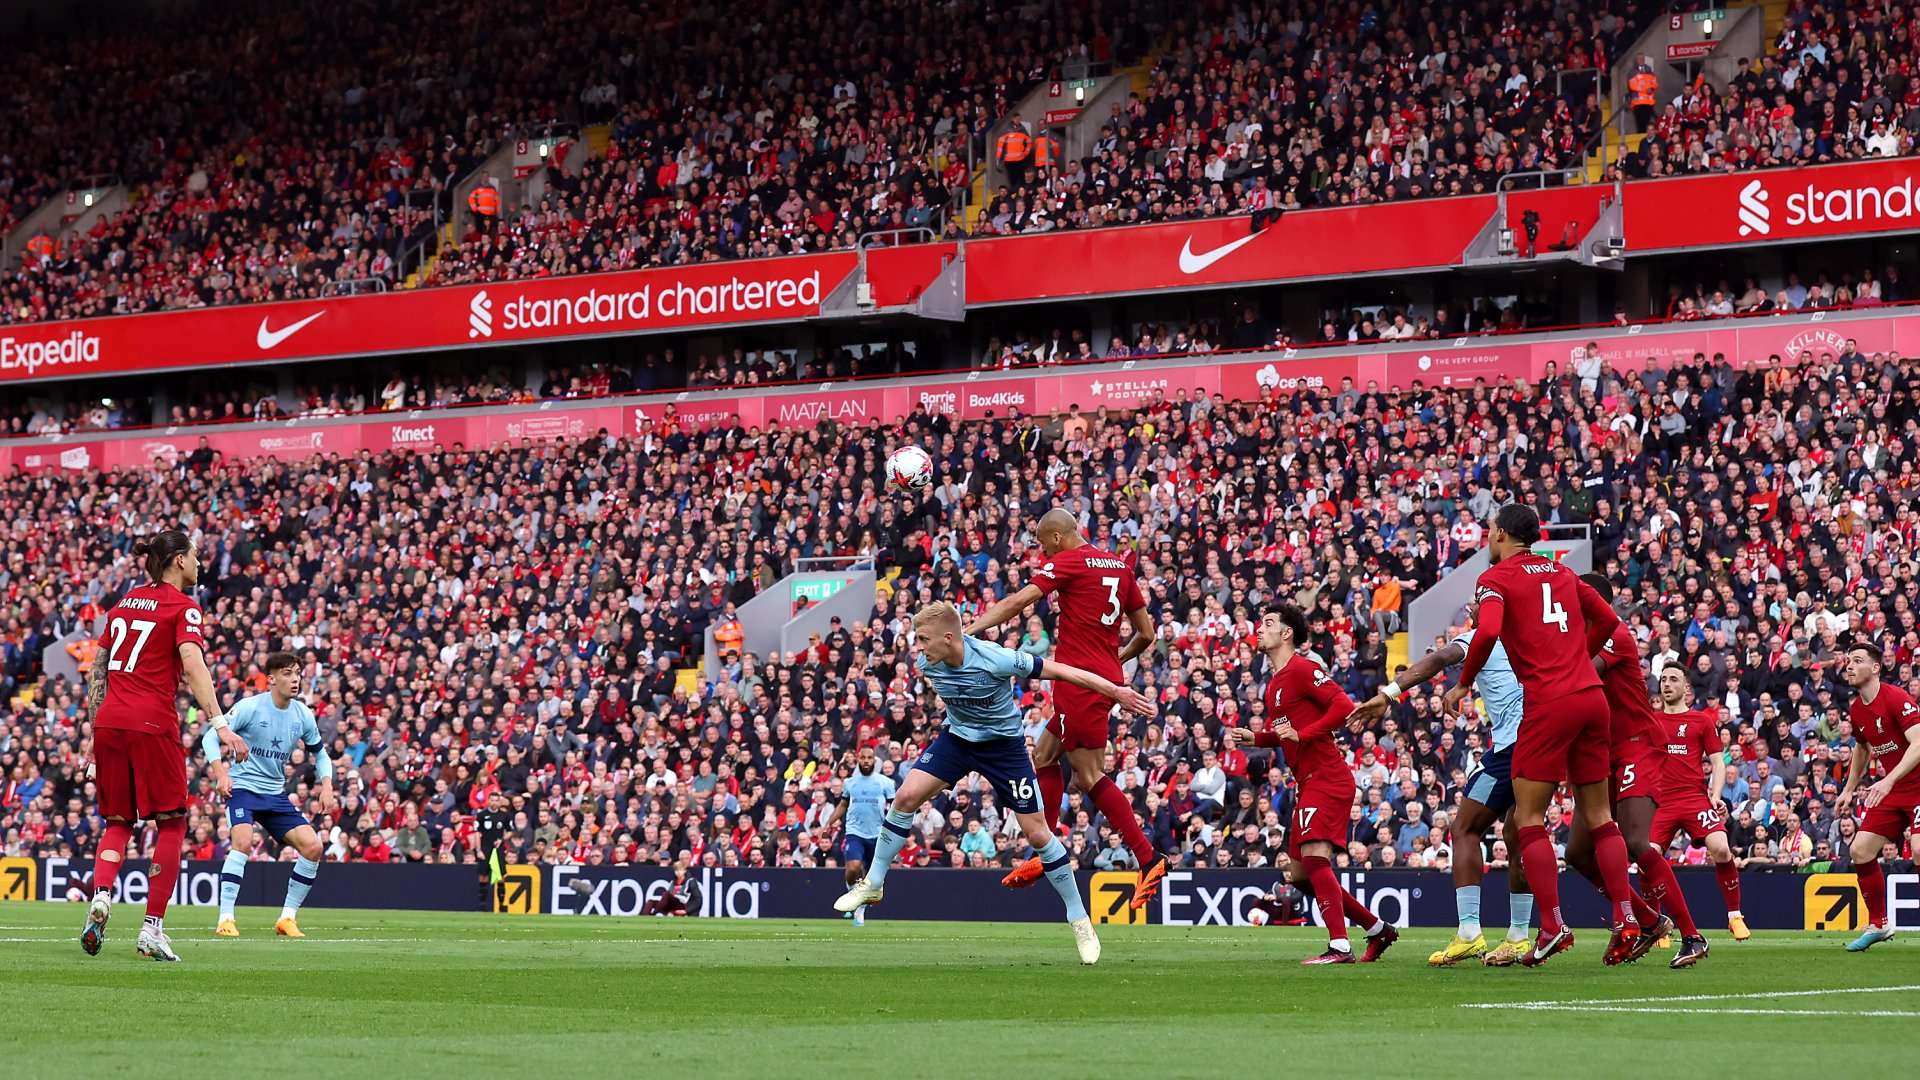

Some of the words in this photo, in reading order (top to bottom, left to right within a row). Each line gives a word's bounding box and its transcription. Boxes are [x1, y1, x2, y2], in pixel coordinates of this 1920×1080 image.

[1671, 15, 1681, 29] 5
[1051, 83, 1060, 96] 4
[518, 142, 526, 154] 3
[1786, 175, 1920, 226] stand
[503, 283, 650, 330] standard
[657, 269, 820, 317] chartered
[1787, 331, 1846, 355] KILNER
[1, 330, 101, 375] Expedia
[1435, 358, 1449, 366] THE
[1452, 357, 1471, 365] VERY
[1473, 355, 1500, 364] GROUP
[1106, 379, 1168, 392] STELLAR
[920, 390, 956, 404] Barrie
[969, 391, 1025, 408] Box4Kids
[1108, 390, 1153, 400] FOOTBA
[780, 399, 867, 422] MATALAN
[392, 425, 435, 443] Kinect
[1085, 557, 1126, 569] FABINHO
[1521, 562, 1559, 575] VIRGIL
[796, 584, 820, 597] EXIT
[118, 597, 159, 612] DARWIN
[1101, 576, 1120, 626] 3
[1541, 582, 1568, 632] 4
[107, 617, 157, 673] 27
[1622, 763, 1636, 785] 5
[1008, 777, 1034, 800] 16
[1298, 807, 1318, 829] 17
[1697, 808, 1721, 828] 20
